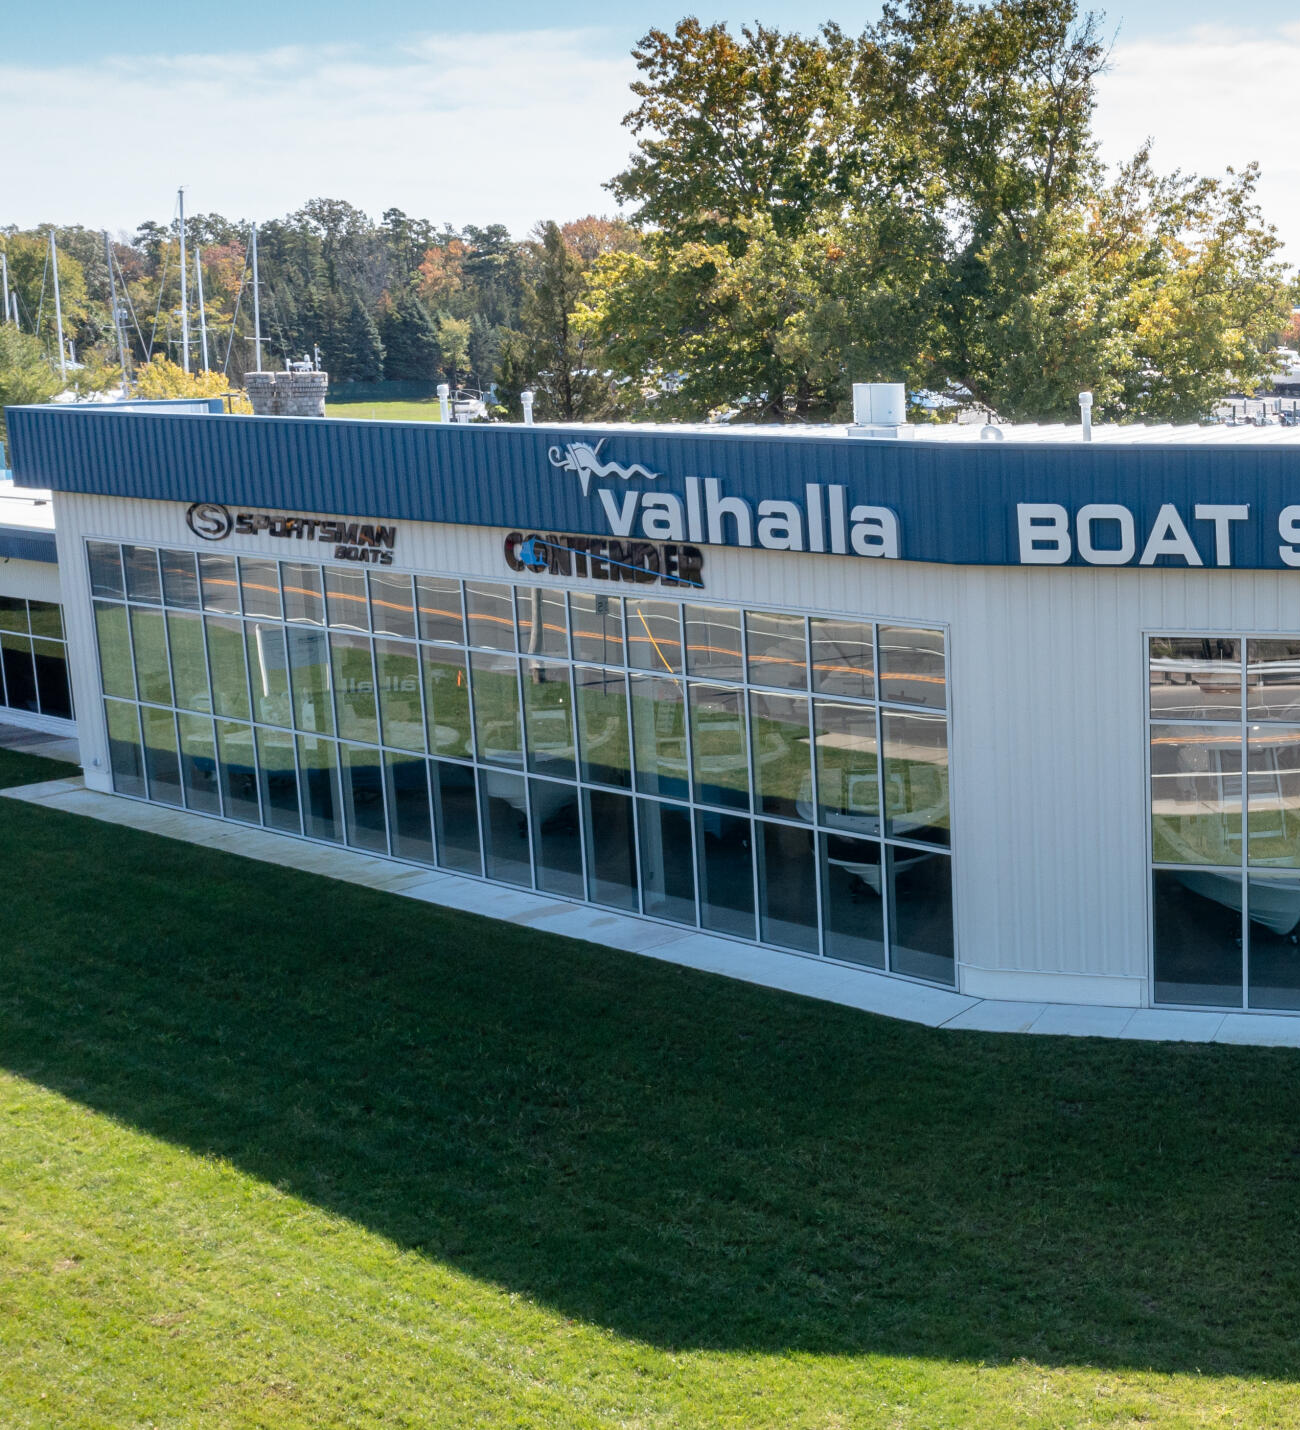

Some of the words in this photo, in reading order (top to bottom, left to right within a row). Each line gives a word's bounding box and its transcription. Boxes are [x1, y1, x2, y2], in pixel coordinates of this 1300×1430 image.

[236, 513, 396, 548] SPORTSMAN
[598, 477, 900, 559] valhalla
[1017, 503, 1250, 566] BOAT
[334, 545, 394, 565] BOATS
[504, 532, 704, 589] CONTENDER
